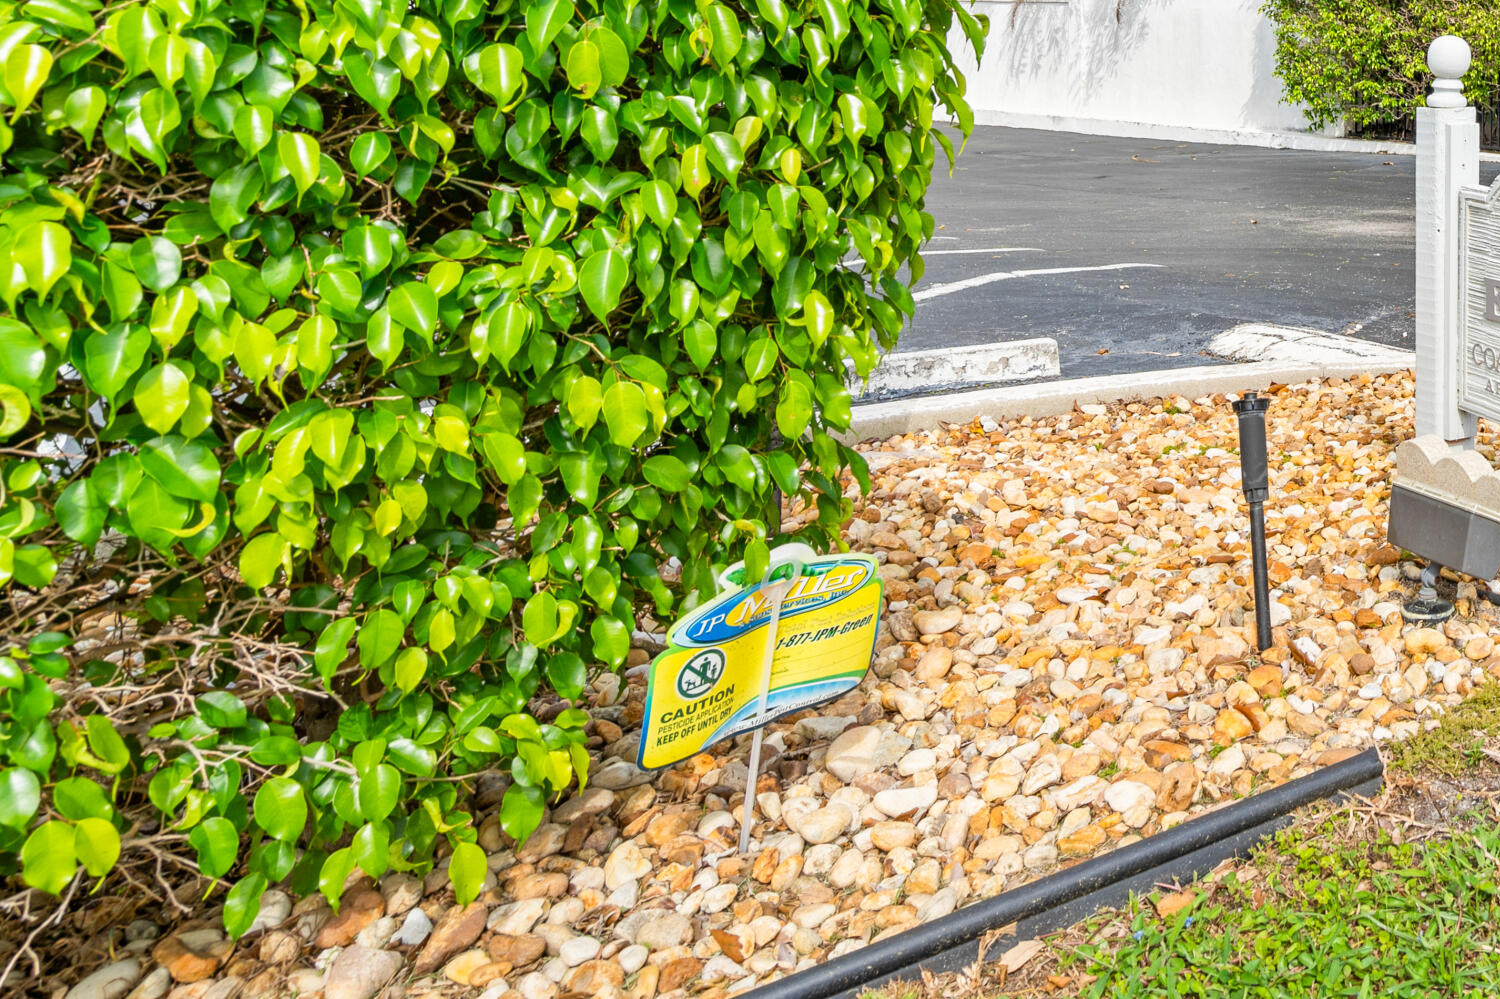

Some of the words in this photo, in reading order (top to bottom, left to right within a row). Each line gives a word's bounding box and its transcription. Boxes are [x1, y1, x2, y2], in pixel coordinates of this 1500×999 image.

[1485, 379, 1495, 393] A
[693, 613, 726, 637] JP
[735, 568, 863, 623] Mller
[775, 613, 874, 650] 1-877-JPM-Green
[658, 716, 694, 735] PESTICIDE
[696, 697, 734, 720] APPLICATION
[660, 684, 735, 723] CAUTION
[656, 731, 679, 747] KEEP
[681, 725, 696, 738] OFF
[697, 715, 718, 731] UNTIL
[720, 706, 733, 720] DRY
